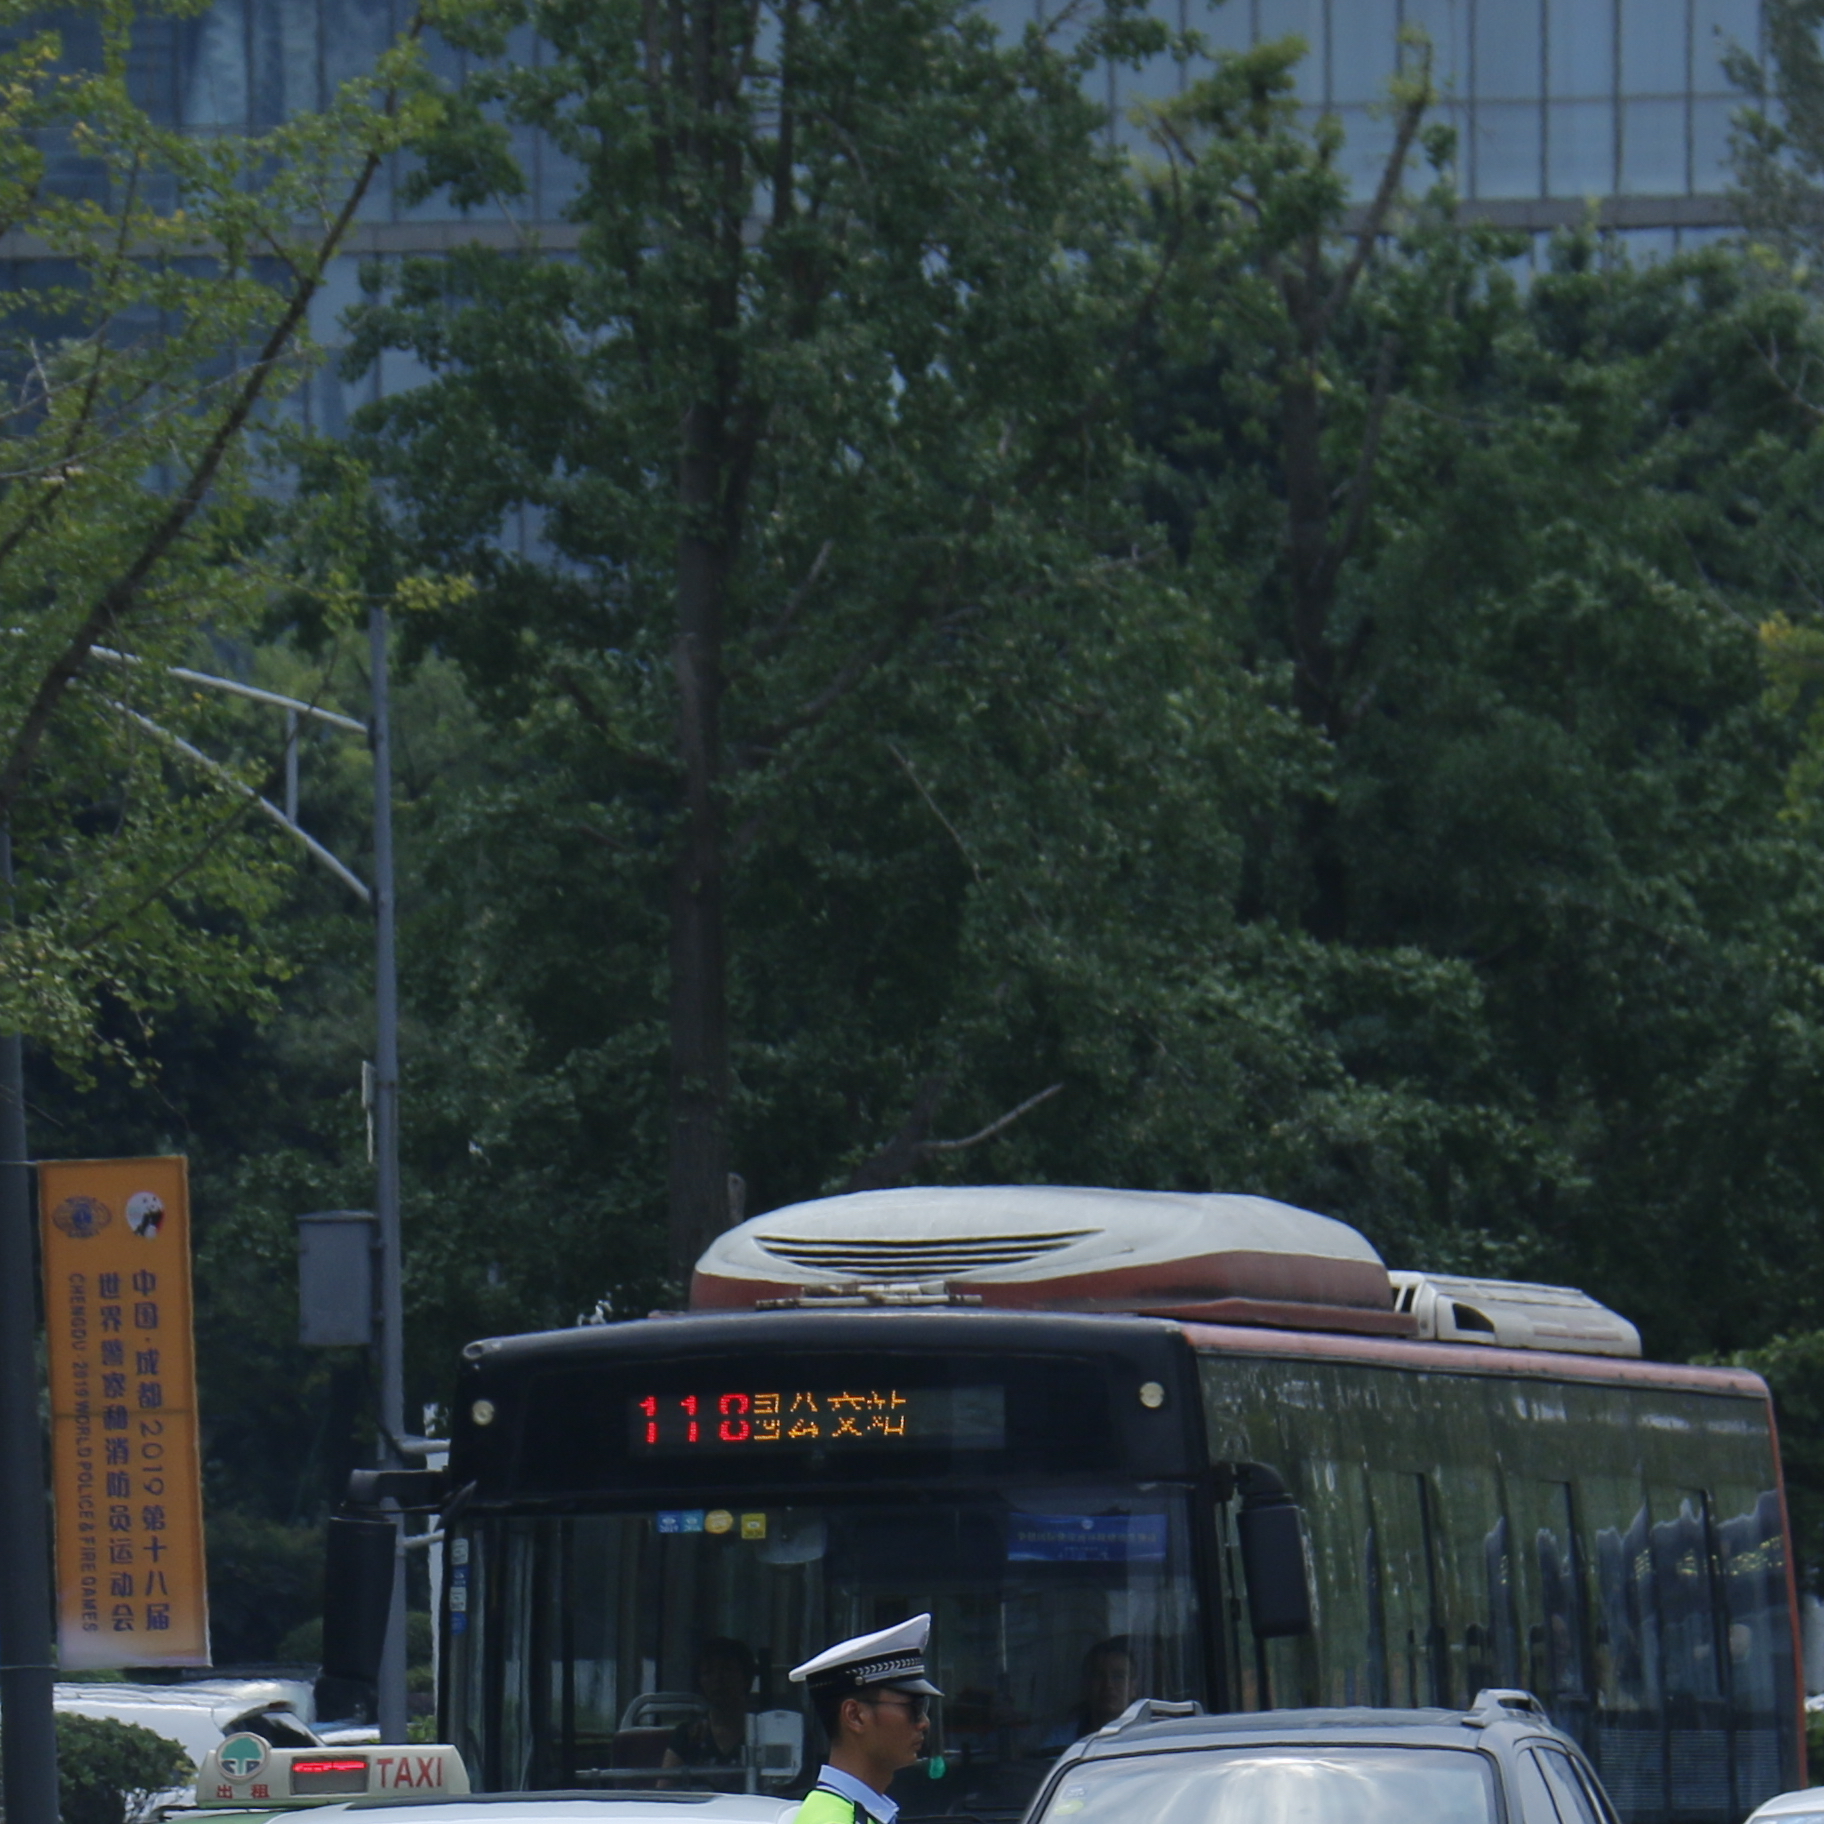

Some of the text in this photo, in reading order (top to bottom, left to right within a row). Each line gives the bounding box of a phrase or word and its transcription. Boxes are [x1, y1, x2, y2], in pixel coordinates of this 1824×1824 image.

[77, 1461, 95, 1519] POLICE
[79, 1536, 97, 1572] FIRE
[81, 1575, 98, 1633] GAMES
[377, 1756, 443, 1788] TAXI
